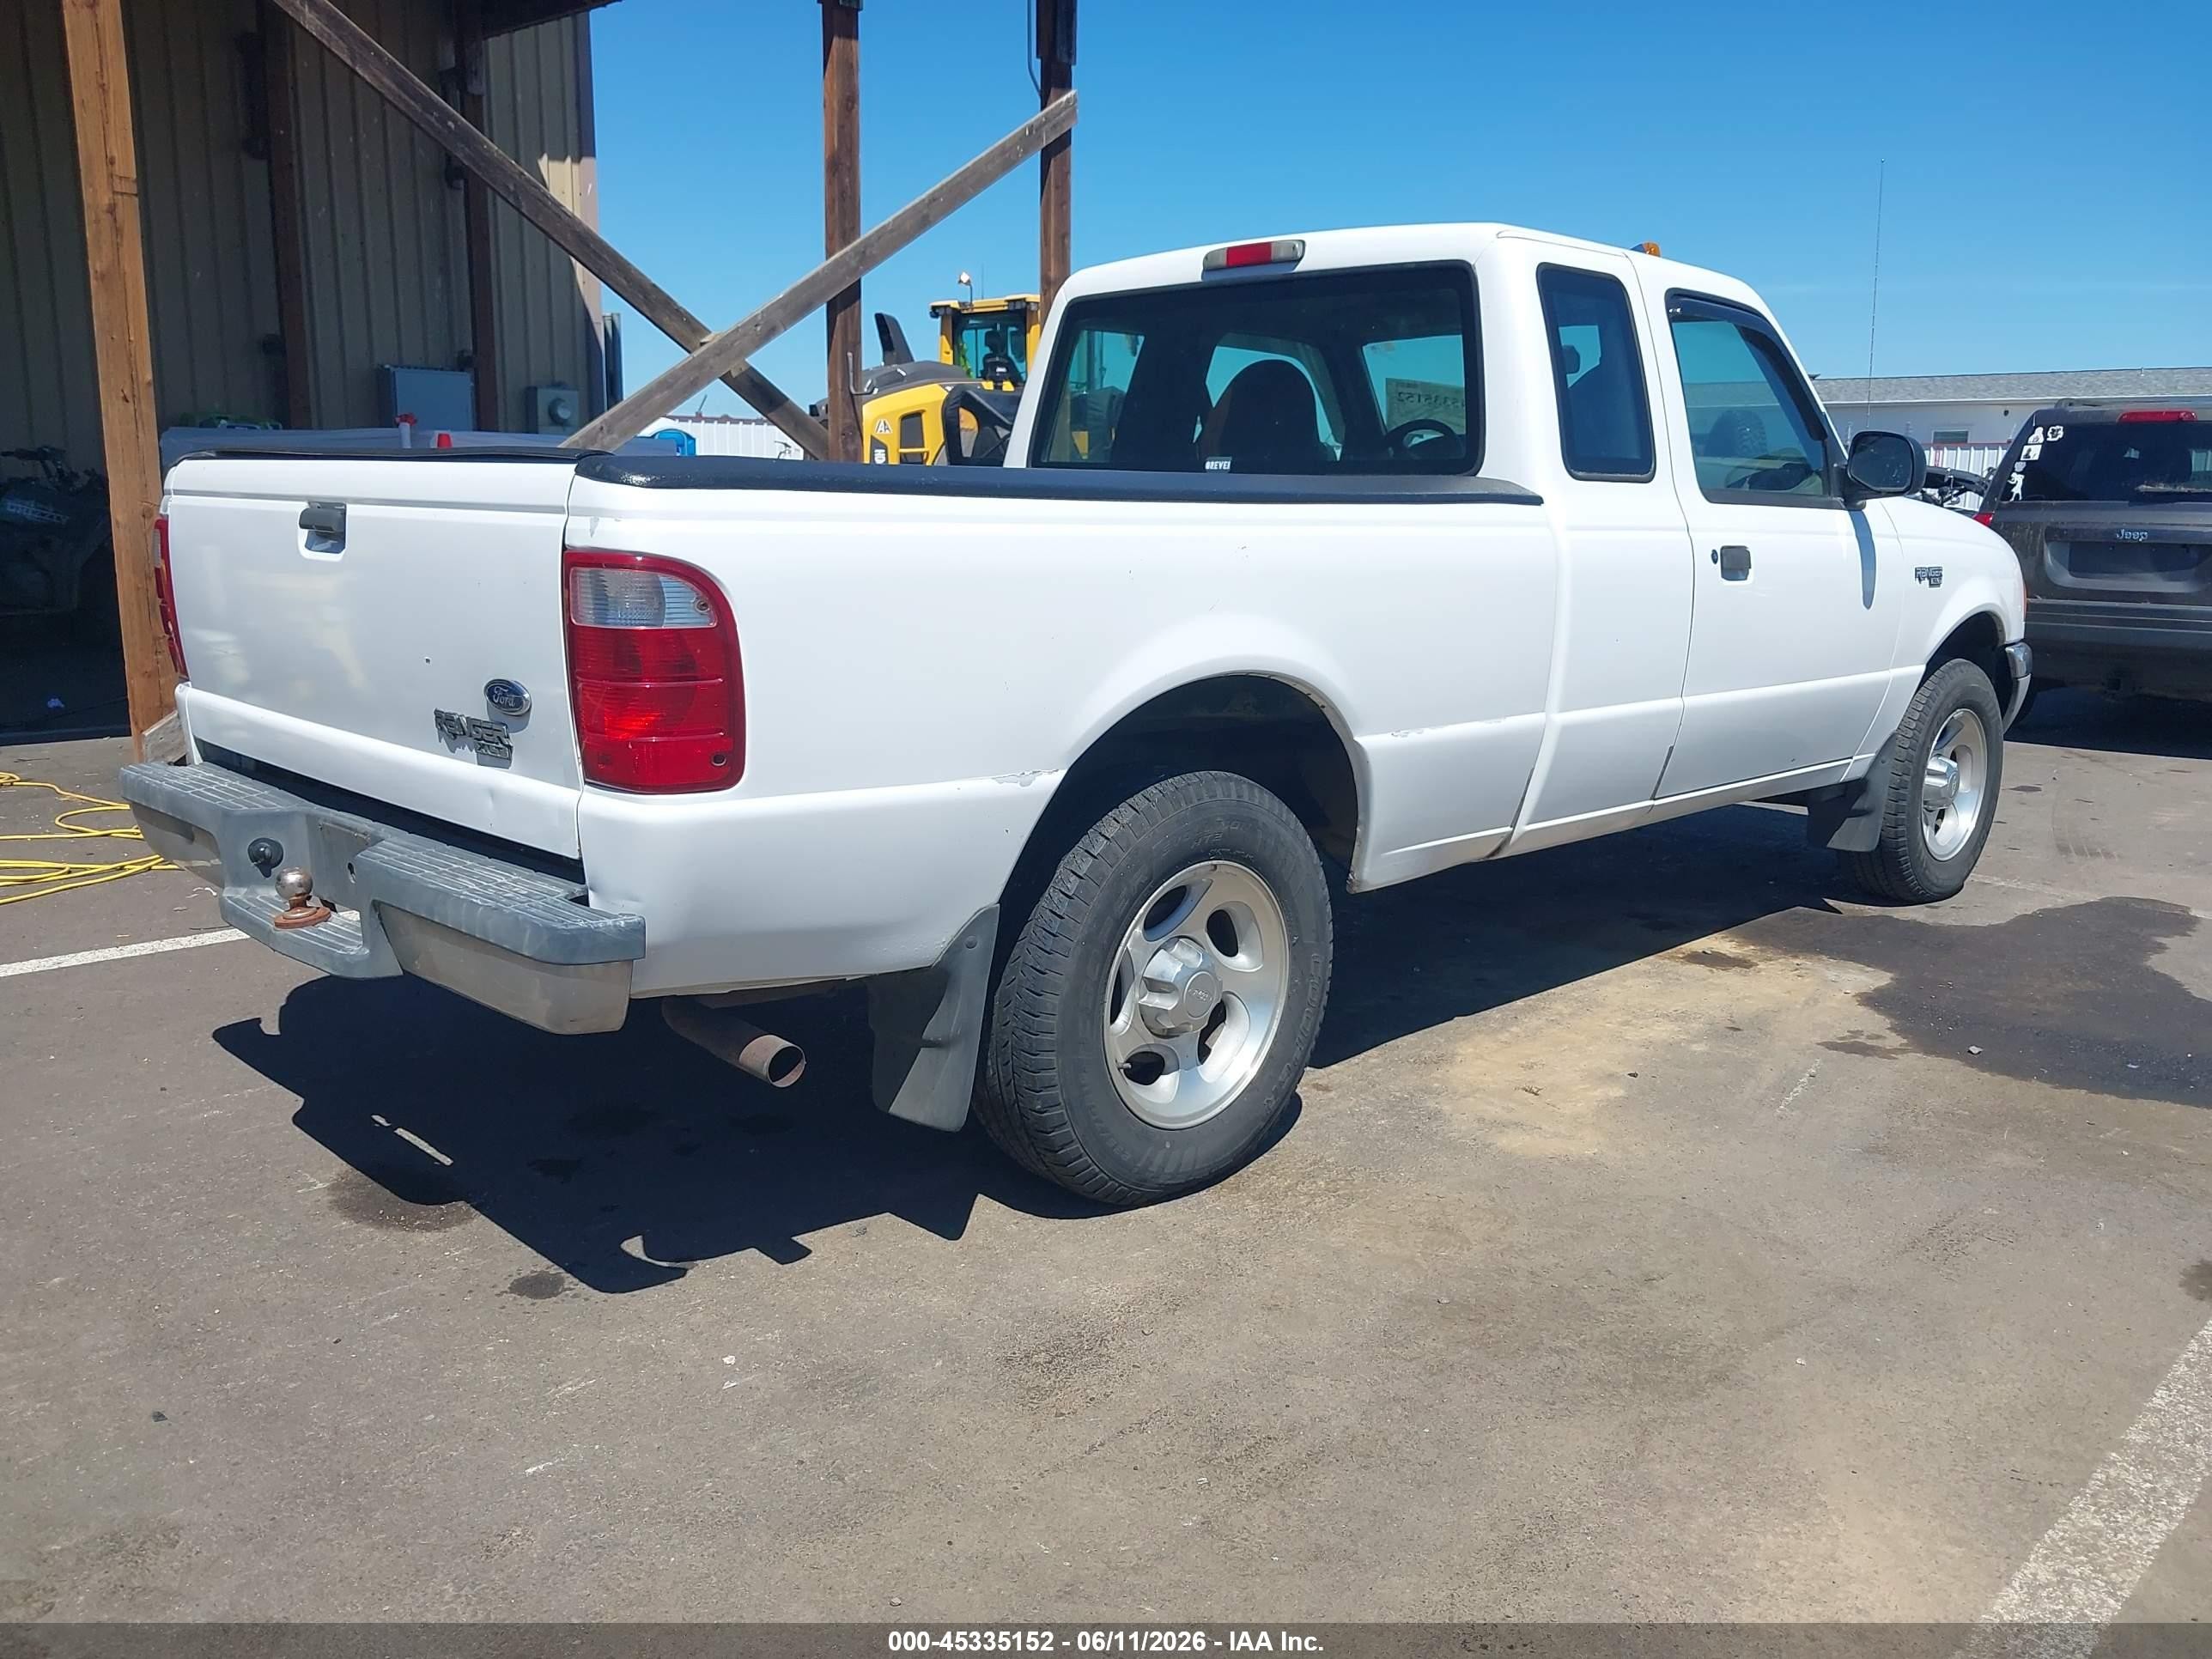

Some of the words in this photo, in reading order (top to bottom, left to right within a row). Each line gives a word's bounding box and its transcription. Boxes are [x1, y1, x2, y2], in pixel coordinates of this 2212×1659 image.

[2116, 528, 2148, 542] Jeep
[1915, 567, 1942, 580] RANGER
[491, 684, 516, 708] Ford
[434, 708, 513, 746] RANGER
